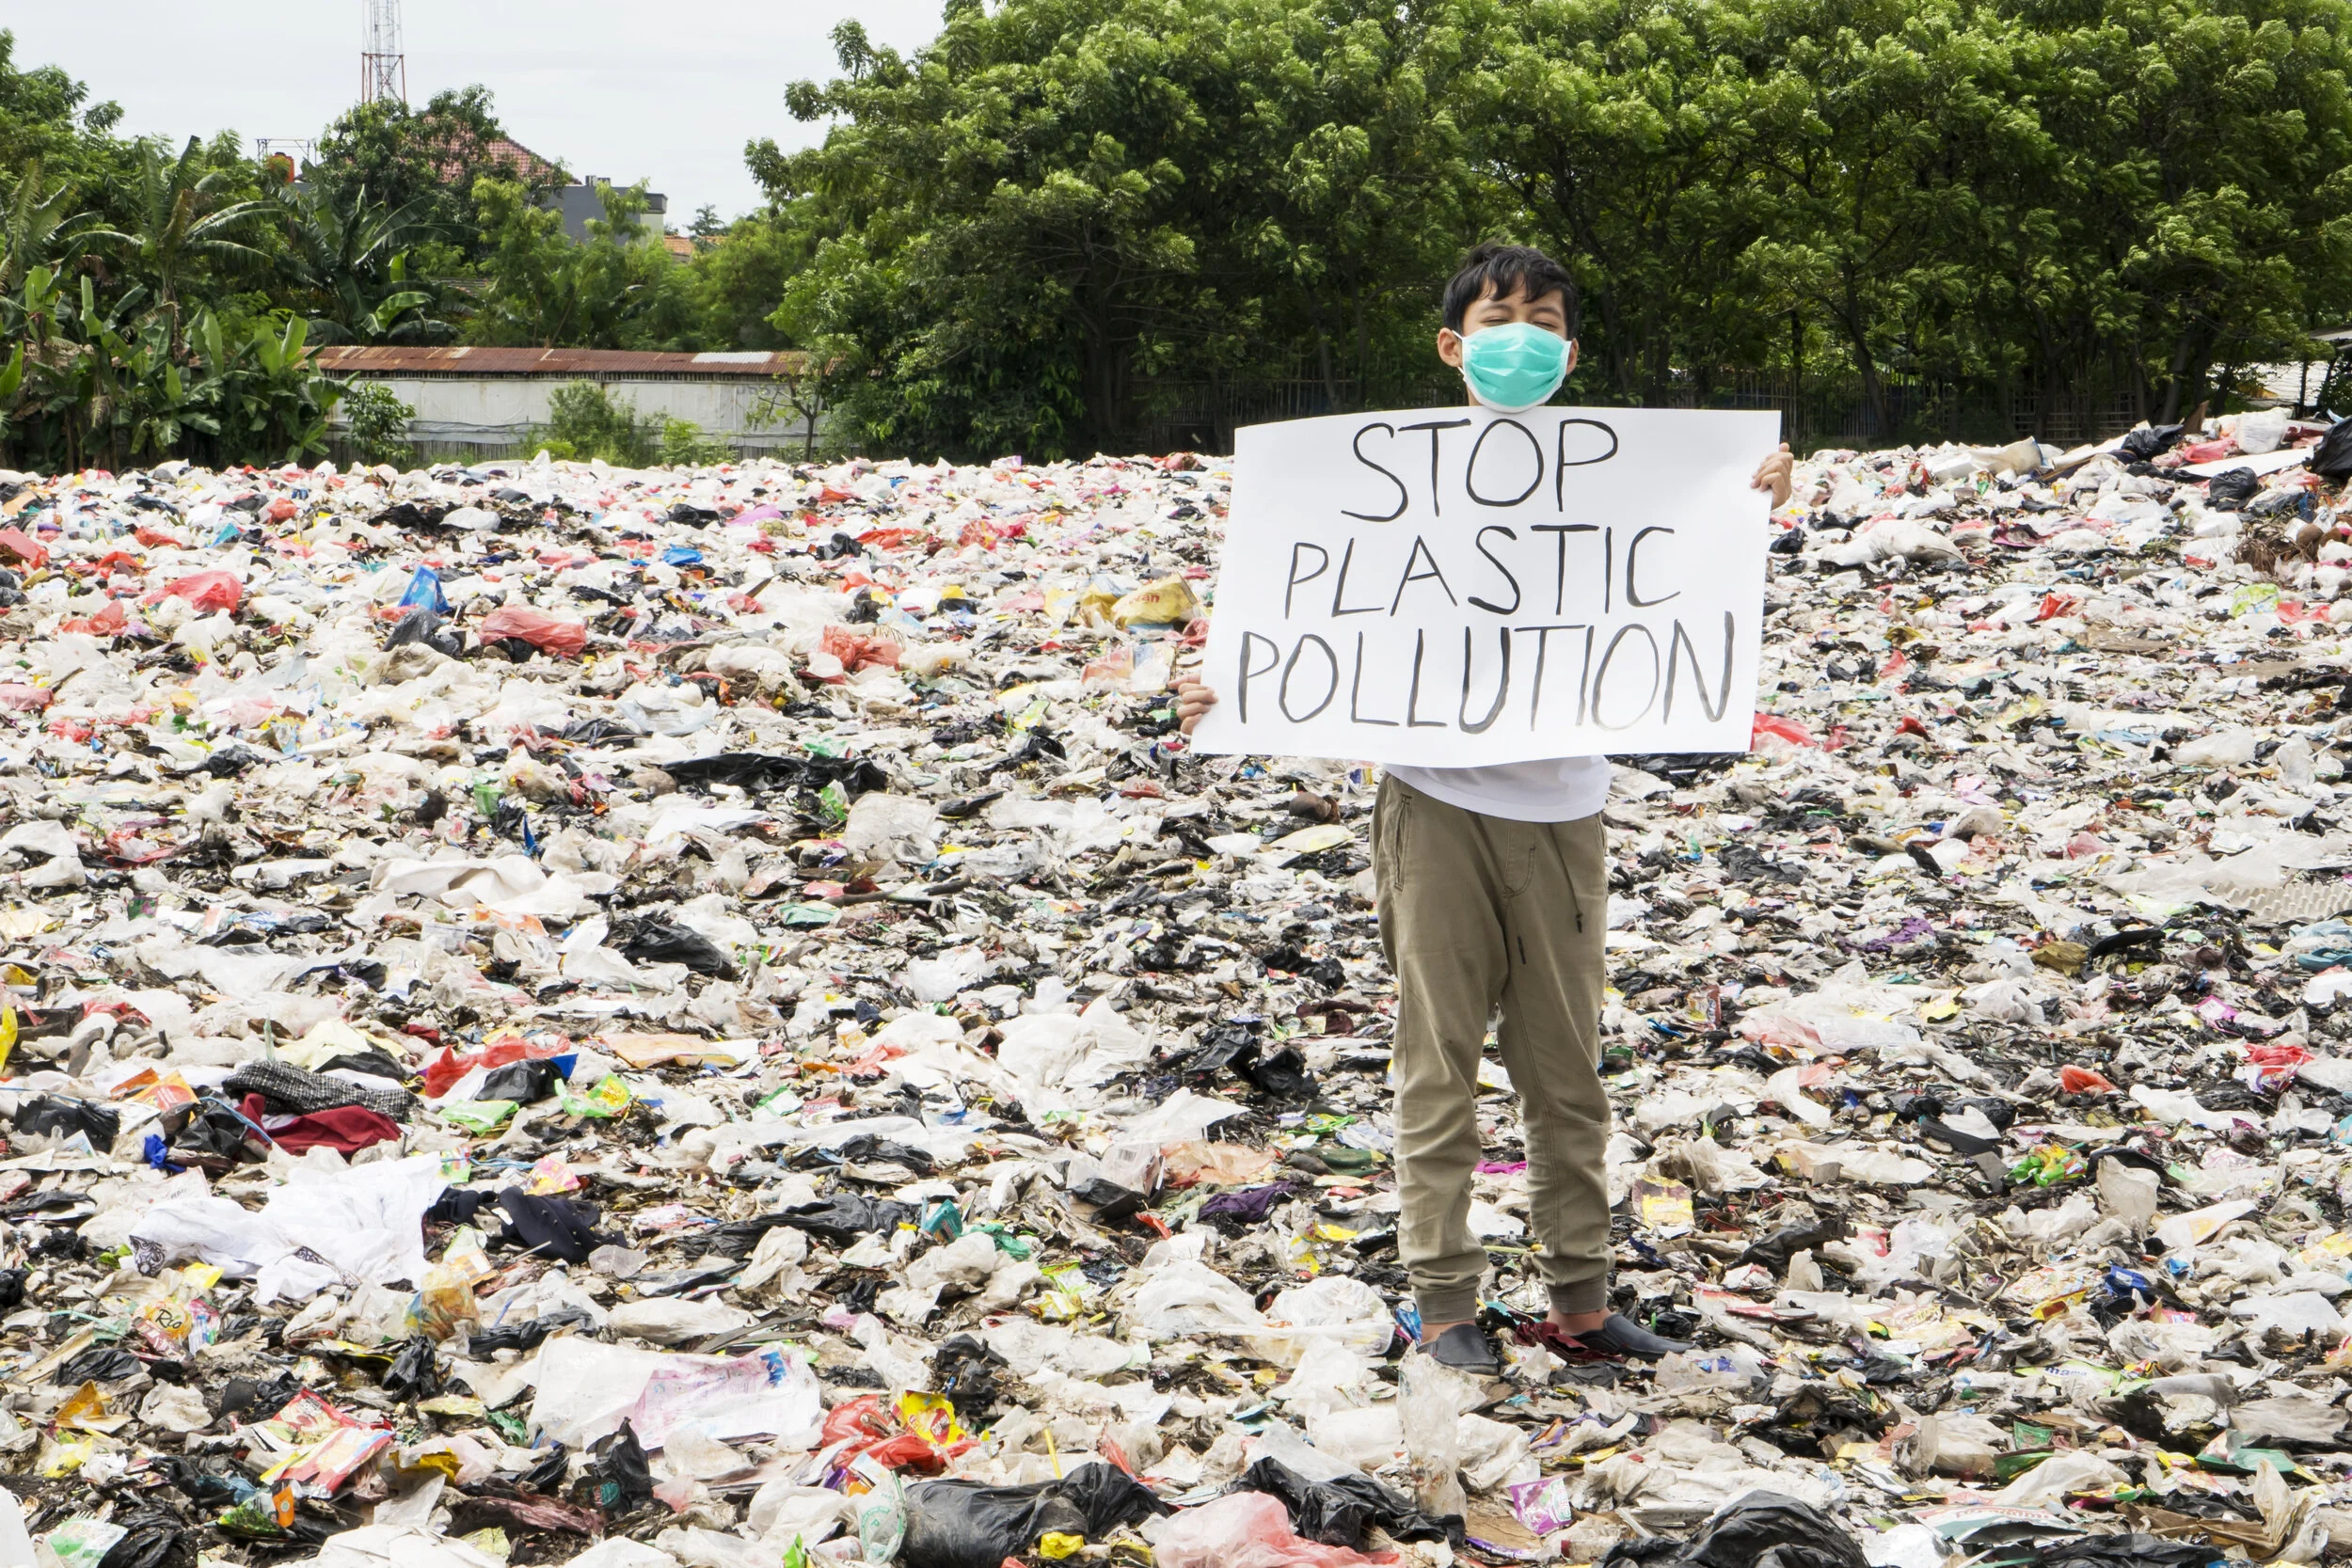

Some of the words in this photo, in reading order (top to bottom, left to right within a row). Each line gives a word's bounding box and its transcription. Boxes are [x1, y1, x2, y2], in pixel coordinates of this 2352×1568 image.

[1340, 418, 1619, 523] STOP
[1284, 523, 1682, 620] PLASTIC
[1237, 610, 1735, 735] POLLUTION
[155, 1308, 183, 1329] Rio
